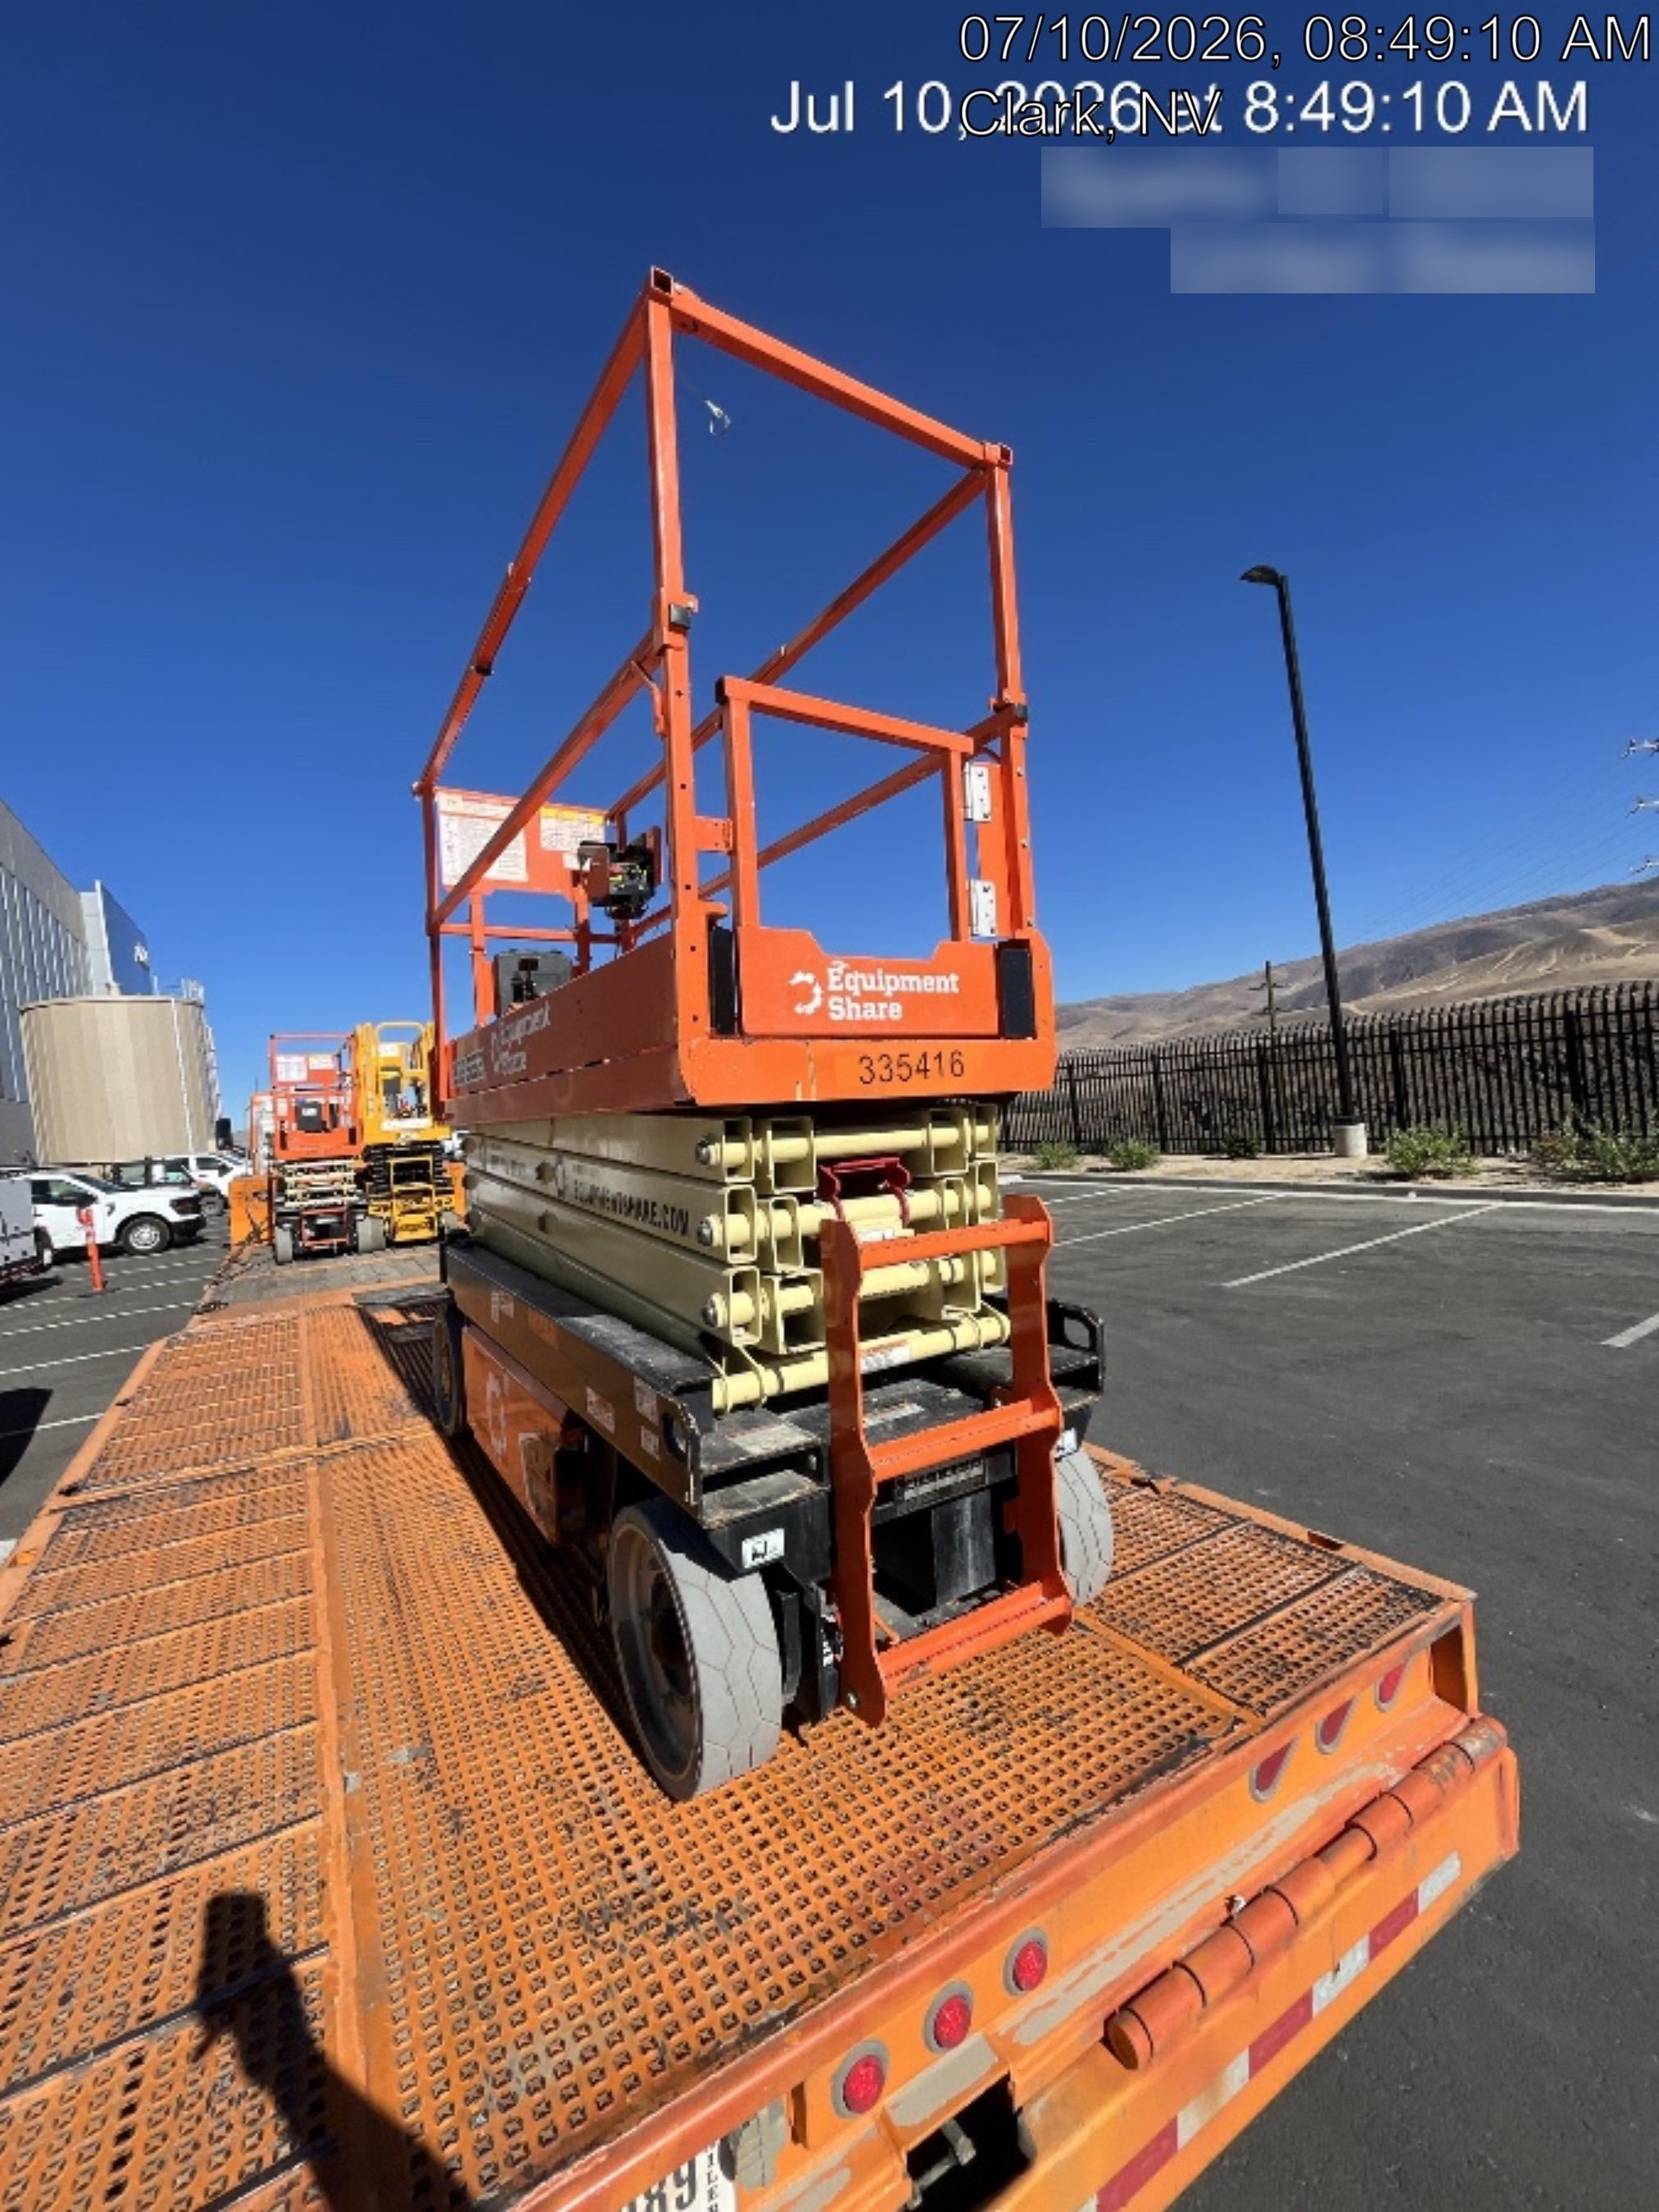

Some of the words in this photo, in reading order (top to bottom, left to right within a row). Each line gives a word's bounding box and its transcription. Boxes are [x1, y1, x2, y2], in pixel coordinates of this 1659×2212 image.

[827, 967, 959, 997] Equipment
[828, 997, 903, 1021] Share
[859, 1049, 965, 1086] 335416
